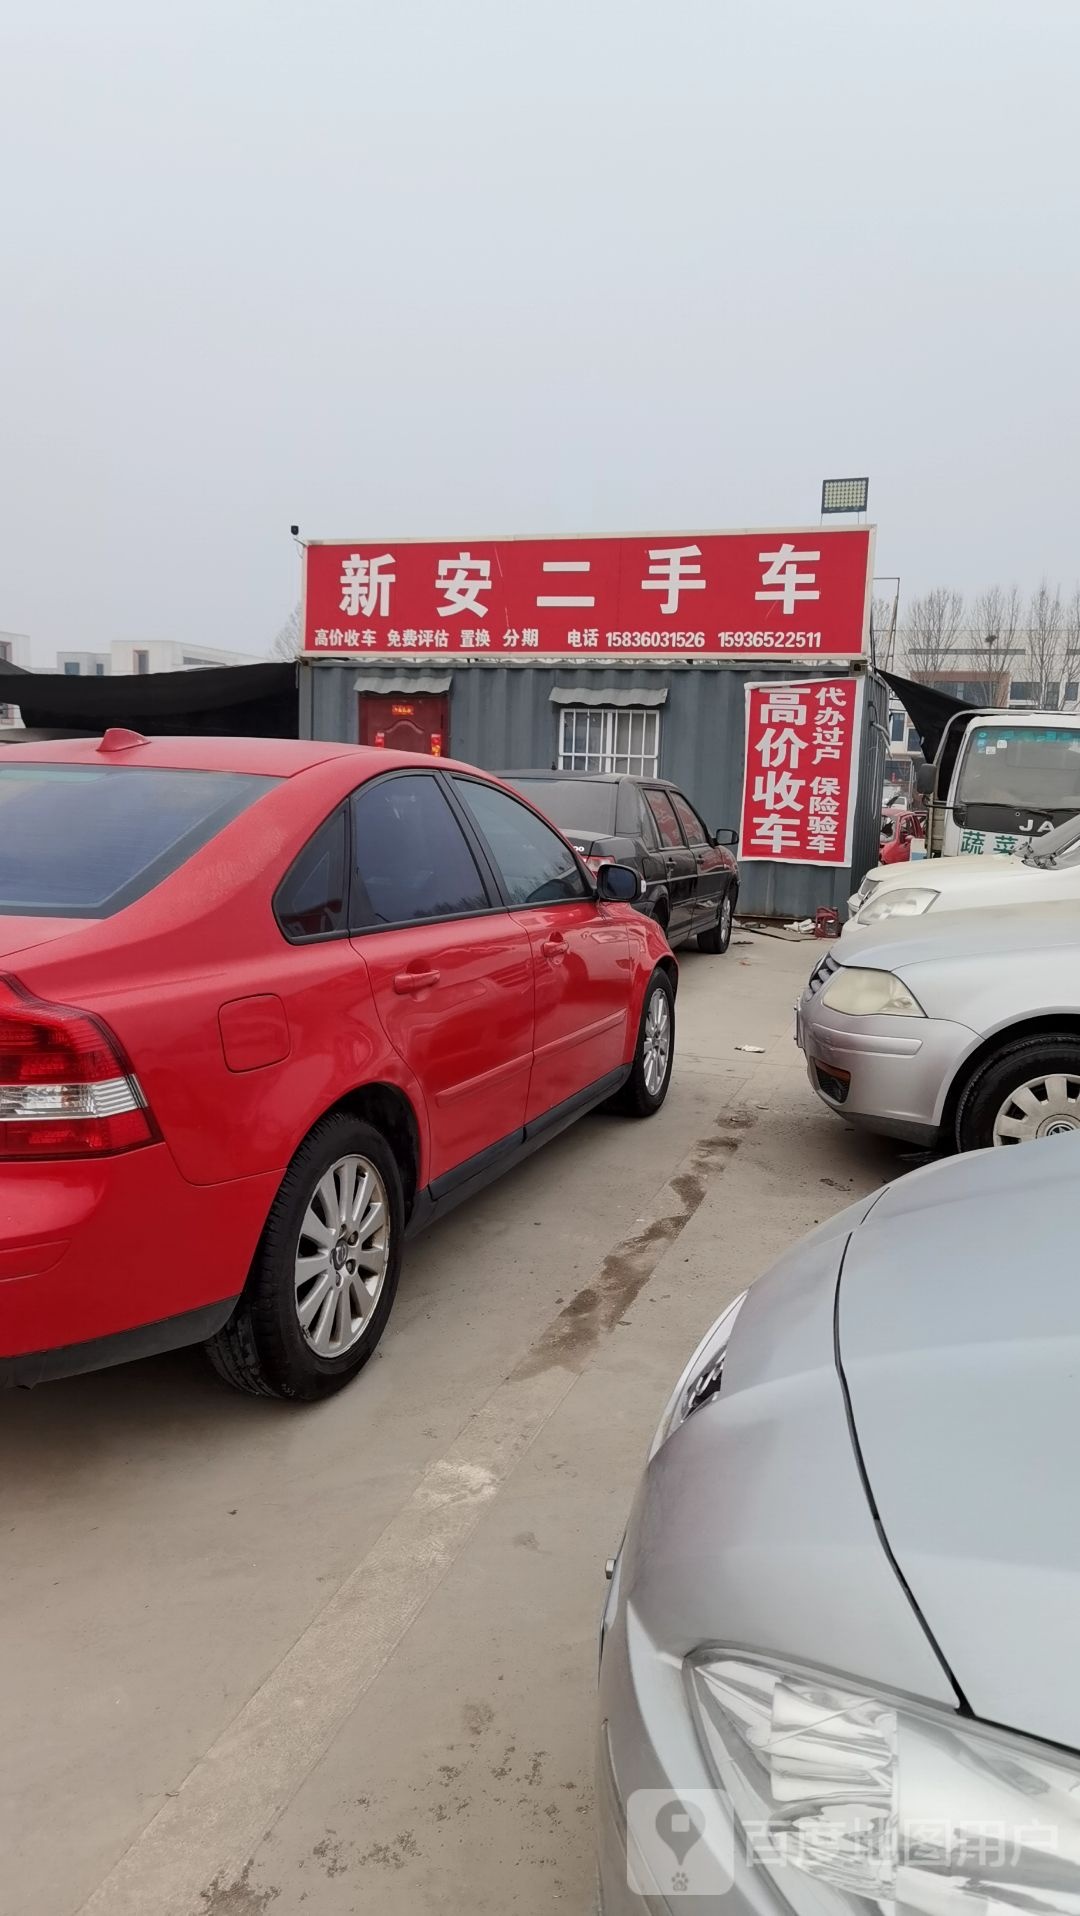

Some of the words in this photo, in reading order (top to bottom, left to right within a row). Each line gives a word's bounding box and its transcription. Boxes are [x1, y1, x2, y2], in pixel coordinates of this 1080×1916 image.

[339, 544, 821, 617] 新安二手车
[314, 629, 377, 647] 高价收车
[386, 629, 449, 648] 免费评估
[459, 629, 490, 648] 置换
[502, 628, 539, 647] 分期
[567, 628, 599, 648] 电话
[605, 631, 705, 648] 15836031526
[717, 631, 821, 648] 15936522511
[811, 687, 847, 766] 代办过户
[750, 686, 811, 854] 高价收车
[806, 776, 841, 854] 保险验车
[960, 830, 1019, 856] 蔬菜
